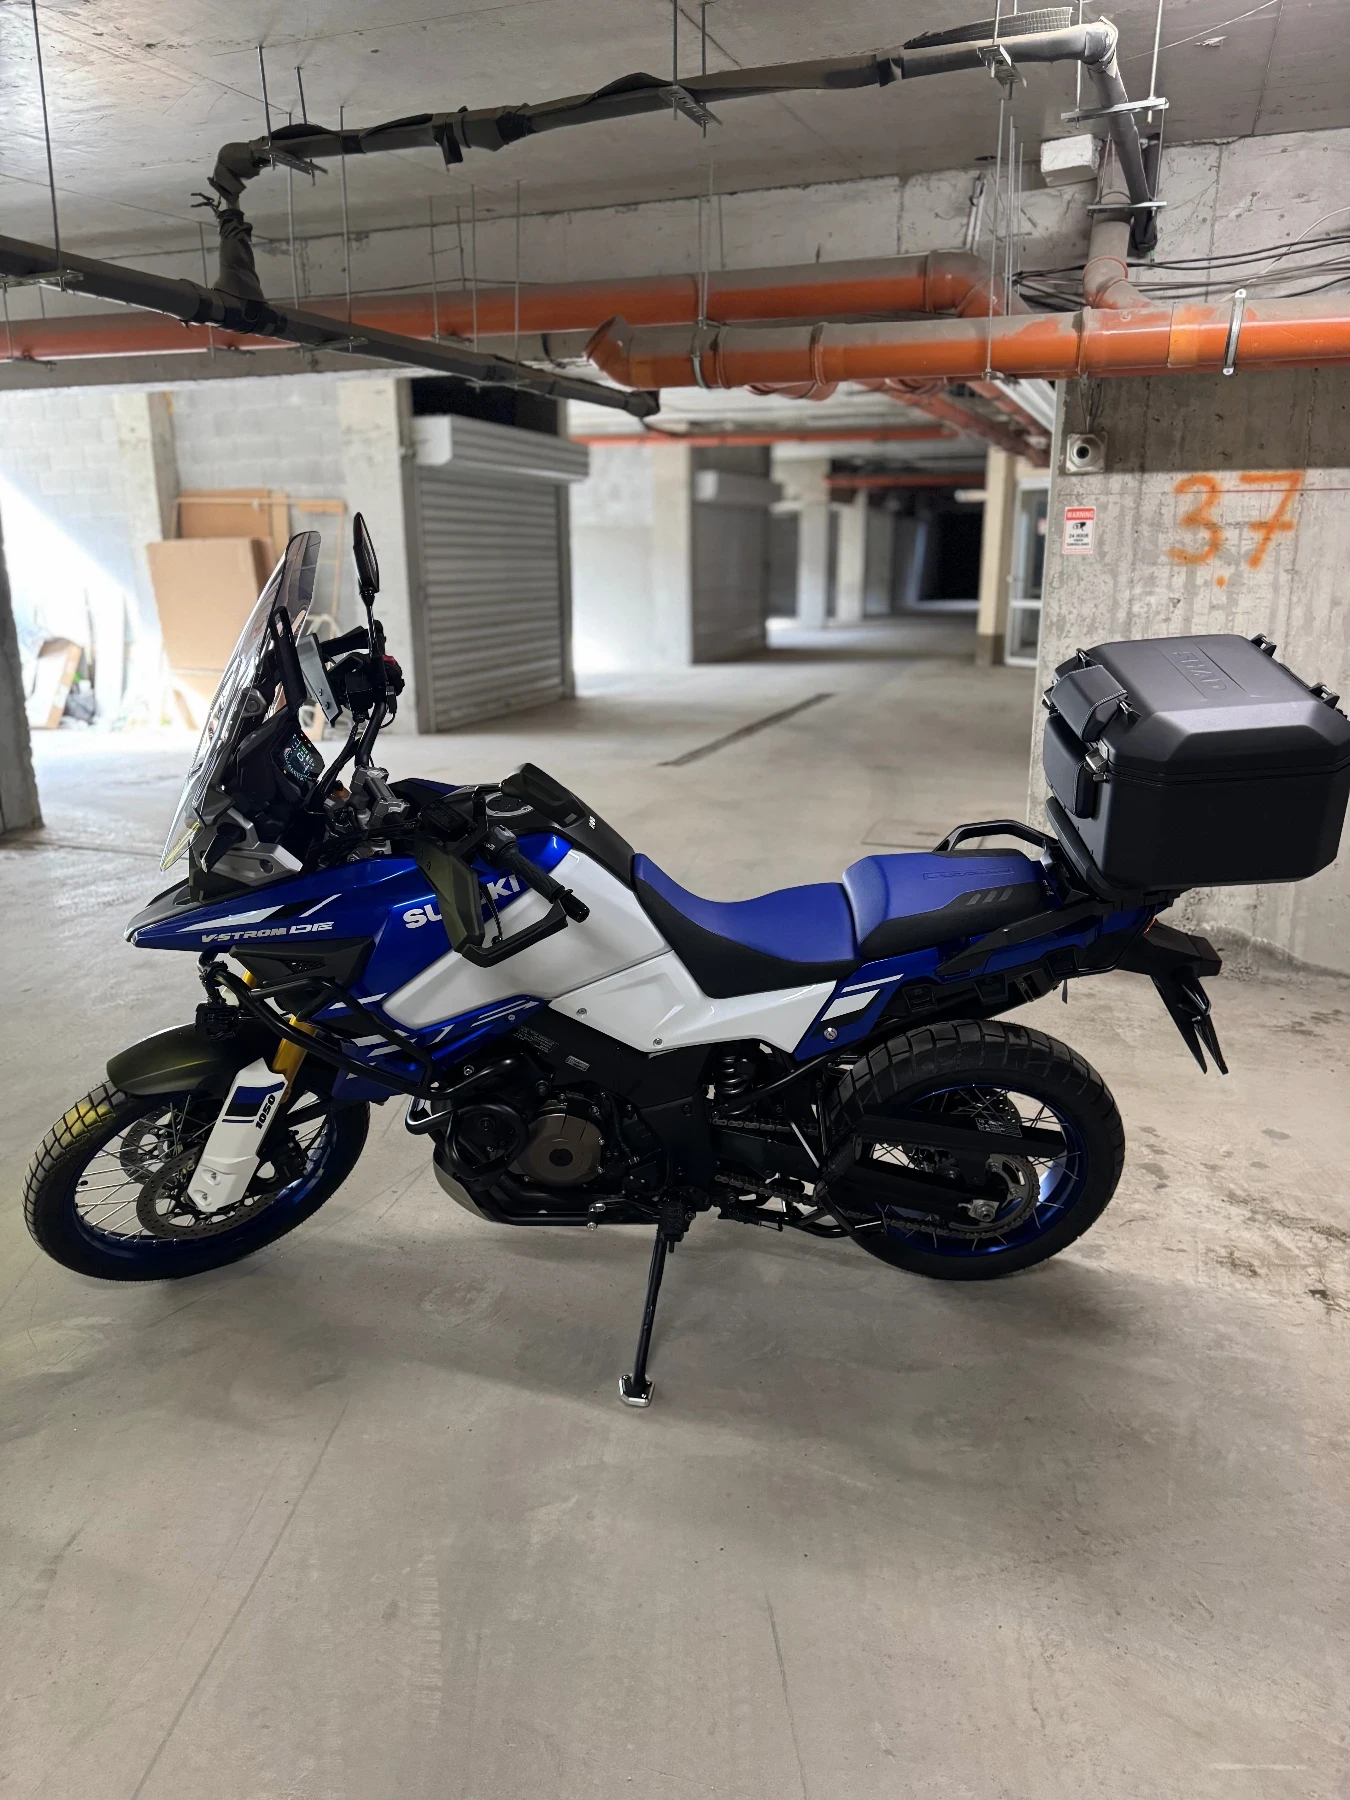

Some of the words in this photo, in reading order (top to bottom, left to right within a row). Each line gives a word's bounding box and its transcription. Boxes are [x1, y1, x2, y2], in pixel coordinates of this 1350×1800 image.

[1067, 510, 1094, 518] WARNING
[1168, 471, 1304, 569] 37
[1172, 650, 1227, 691] SHAD
[402, 874, 521, 929] SUKI
[201, 927, 287, 943] V-STROM
[289, 921, 335, 935] DE
[255, 1093, 276, 1130] 1050
